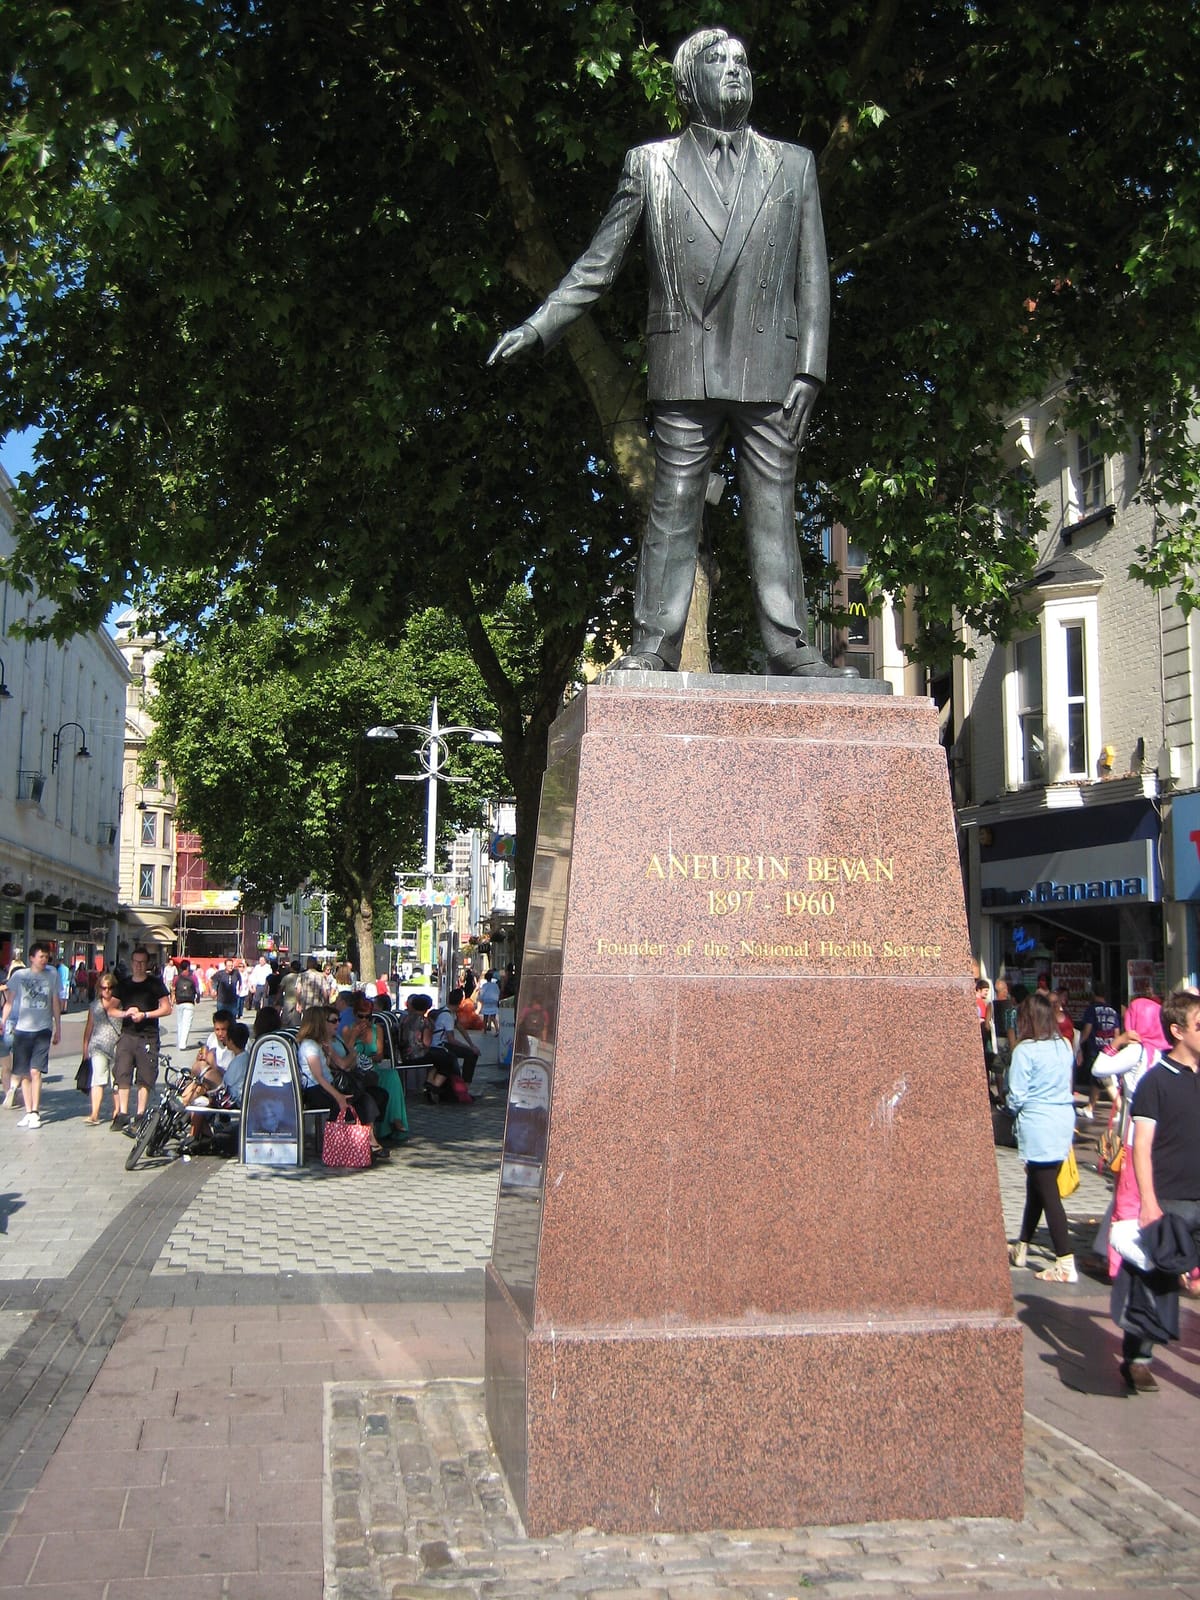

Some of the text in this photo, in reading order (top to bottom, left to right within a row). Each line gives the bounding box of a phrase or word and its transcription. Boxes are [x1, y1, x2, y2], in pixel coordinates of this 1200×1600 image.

[645, 853, 895, 882] ANEURIN BEVAN
[707, 890, 754, 916] 1897
[784, 891, 835, 916] 1960
[597, 938, 941, 958] Founder of the National Health Service
